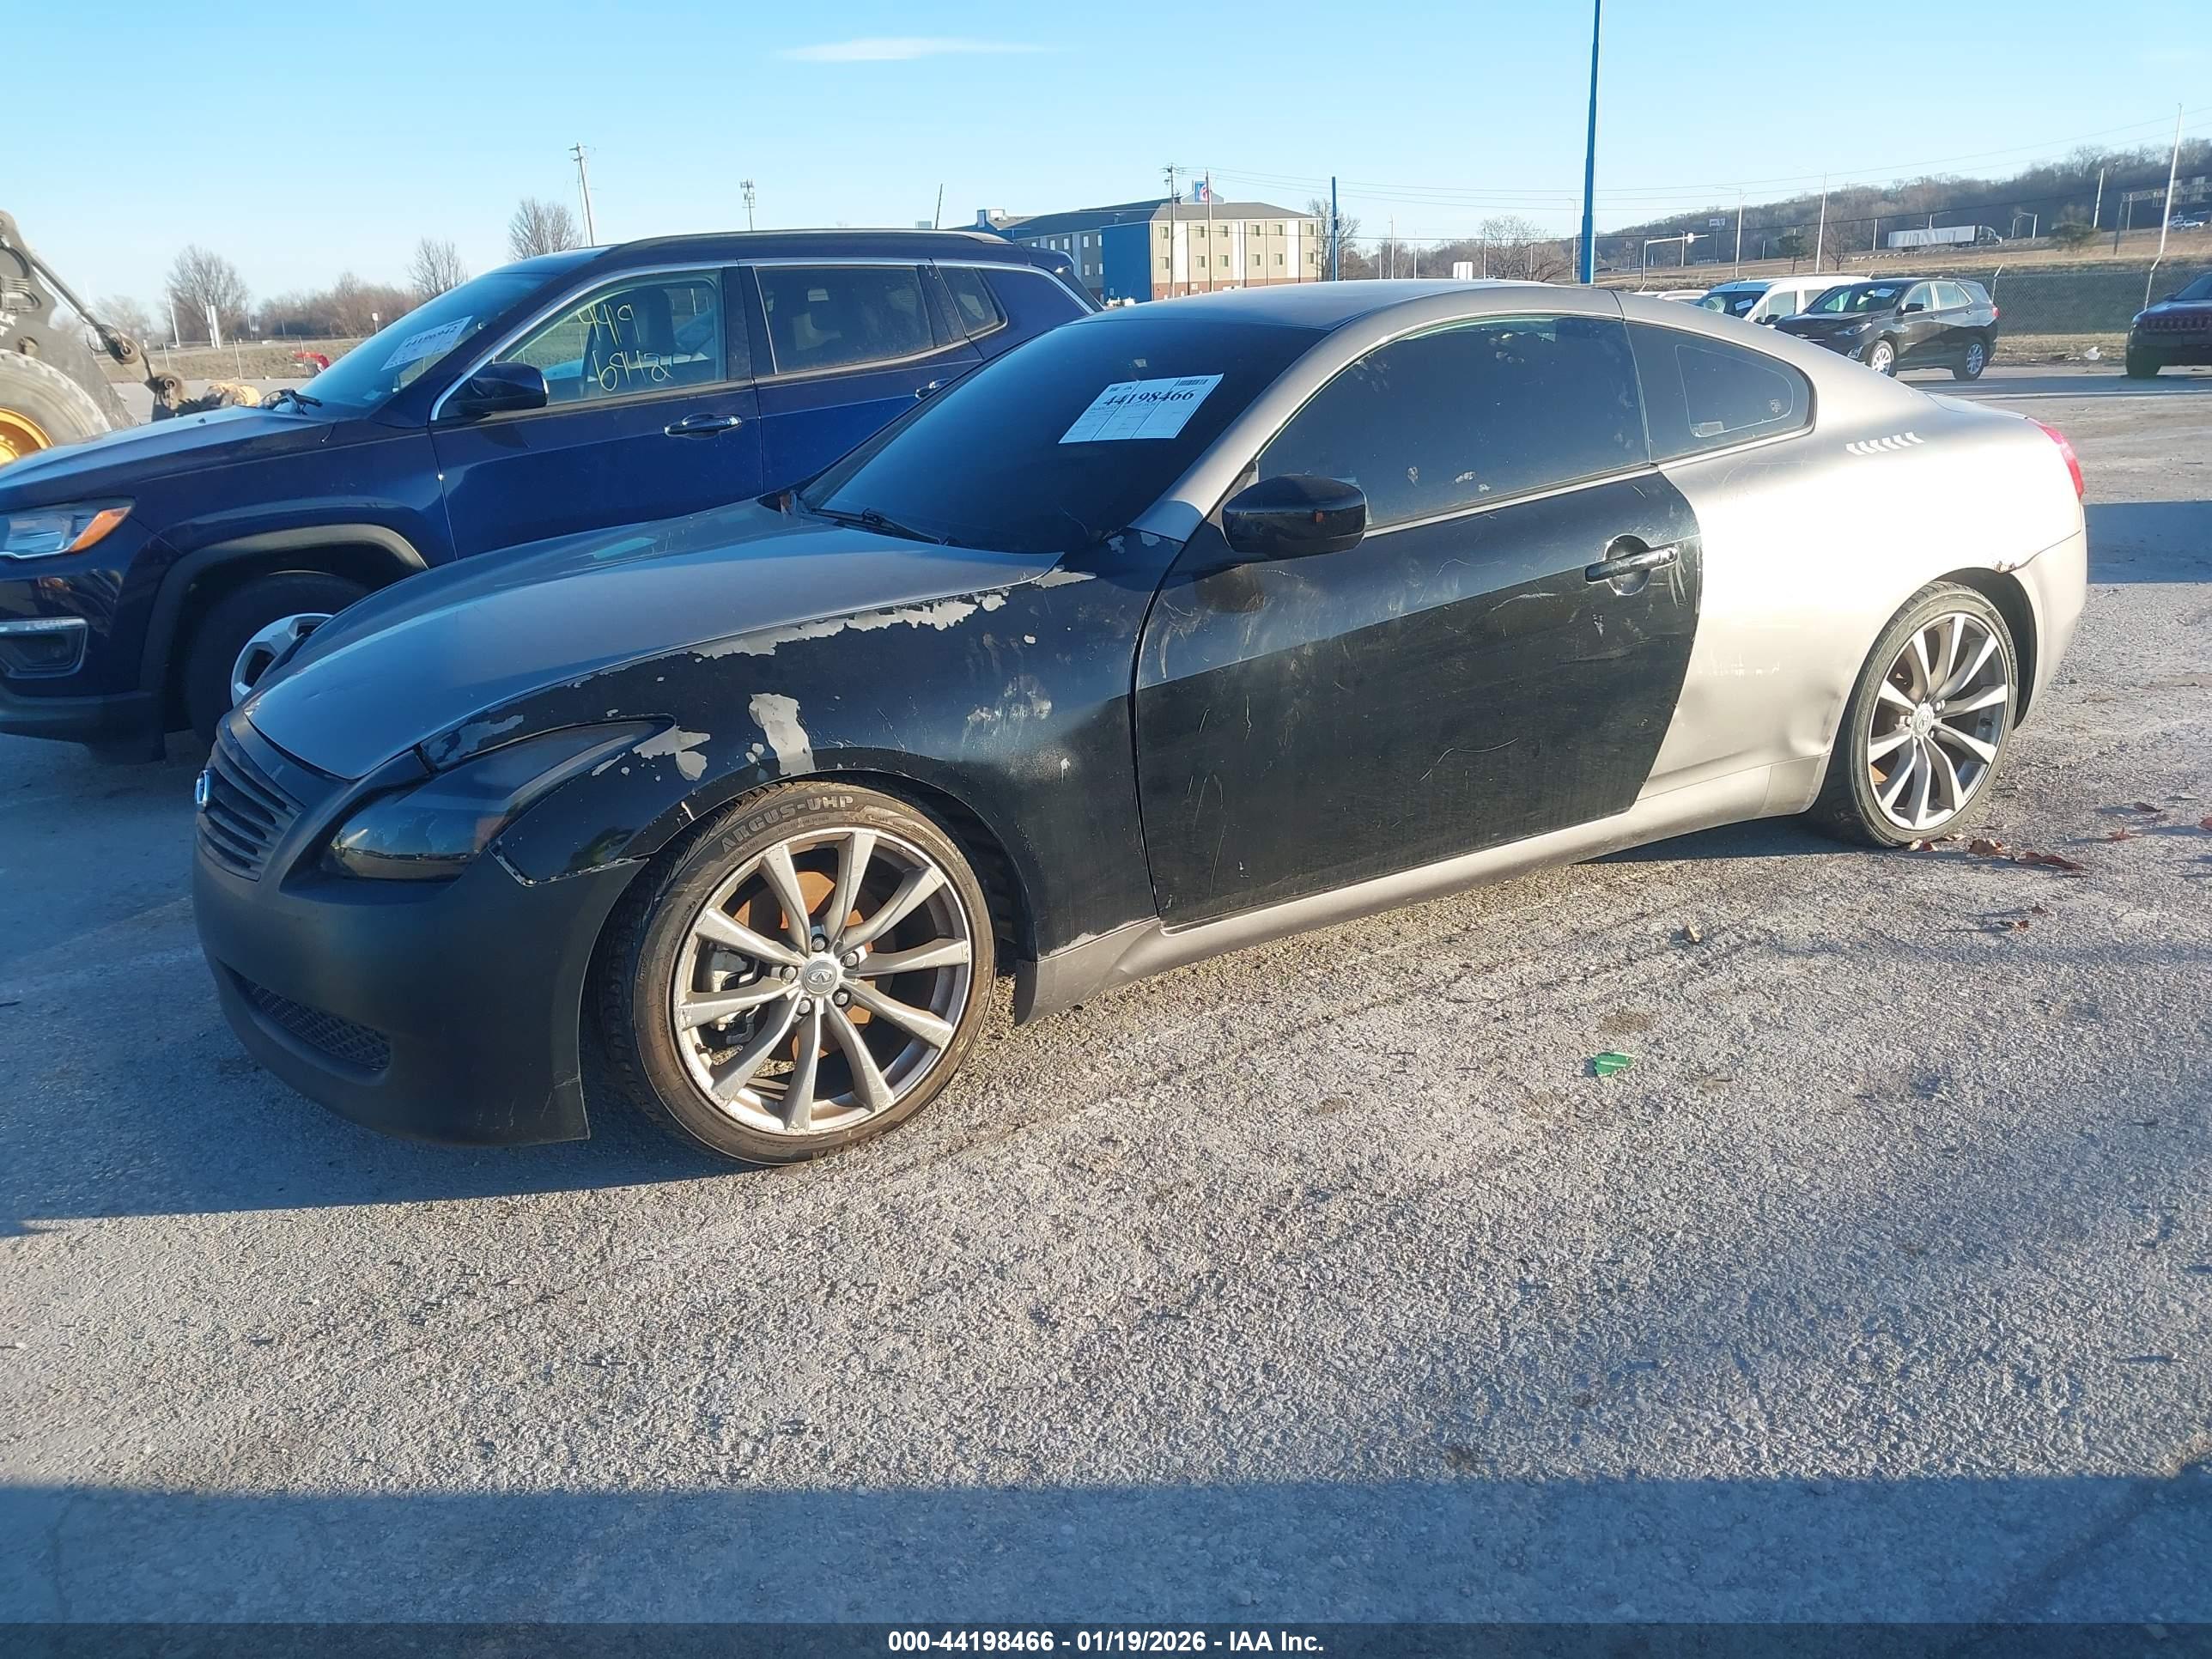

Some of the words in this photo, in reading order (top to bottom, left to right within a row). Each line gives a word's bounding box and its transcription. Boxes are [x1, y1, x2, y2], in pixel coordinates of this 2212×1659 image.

[592, 349, 673, 392] 6942
[1103, 389, 1196, 406] 44198466
[720, 795, 854, 854] ARGUS-UHP
